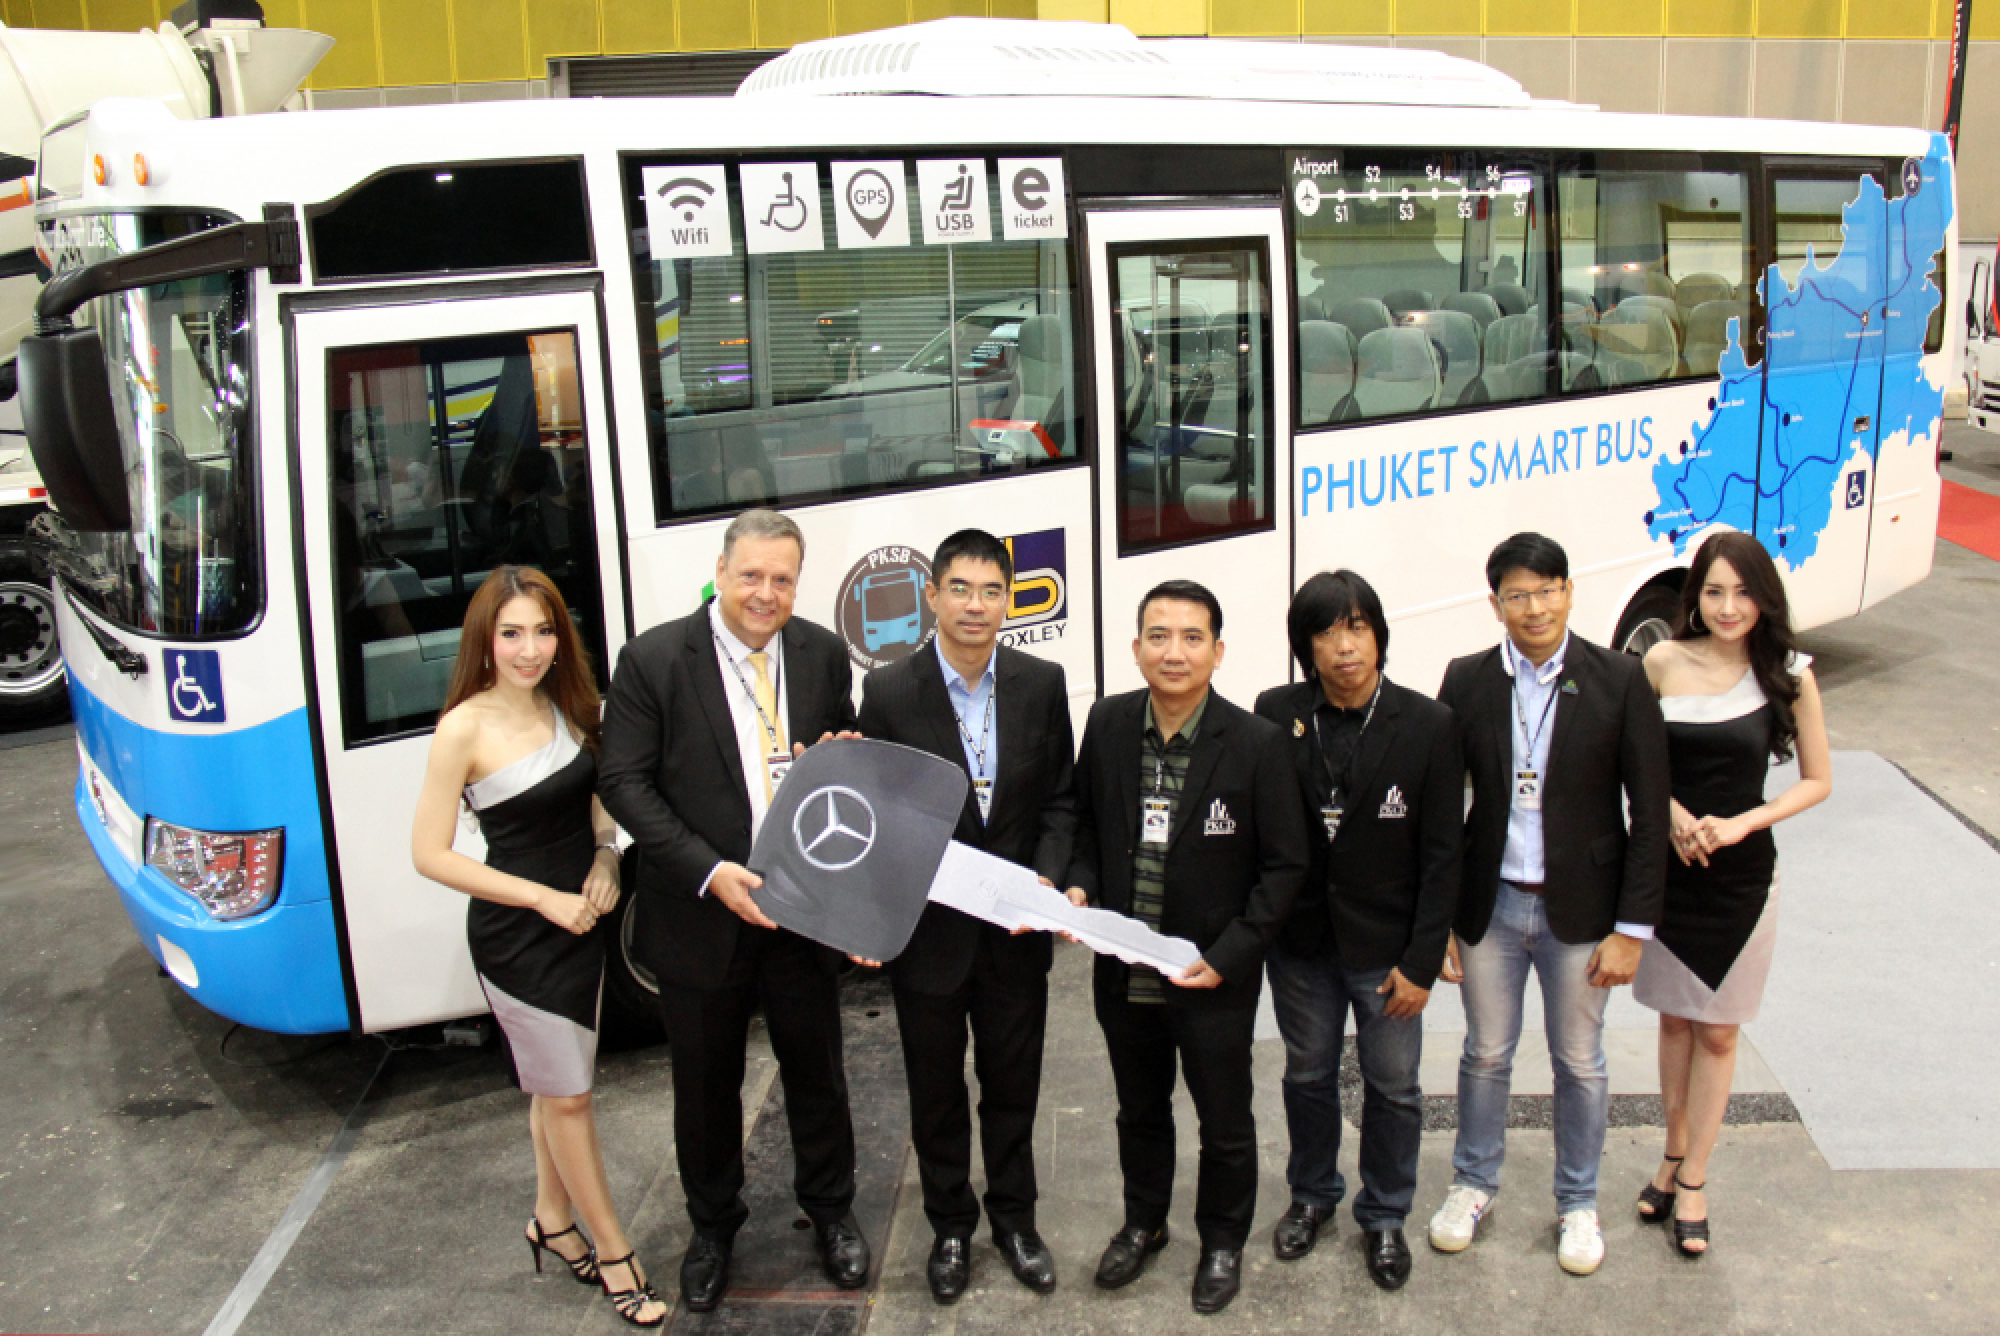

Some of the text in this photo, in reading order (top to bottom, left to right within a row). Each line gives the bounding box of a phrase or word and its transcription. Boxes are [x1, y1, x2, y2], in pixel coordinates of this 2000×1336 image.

[1293, 156, 1339, 179] Airport
[1365, 165, 1381, 183] S2
[1425, 164, 1442, 183] S4
[1485, 164, 1501, 182] S6
[853, 189, 888, 206] GPS
[1012, 167, 1051, 211] e
[1334, 204, 1349, 223] S1
[1399, 203, 1415, 221] S3
[1457, 201, 1473, 219] S5
[1513, 201, 1527, 217] S7
[935, 213, 975, 231] USB
[1013, 213, 1054, 229] ticket
[670, 228, 709, 246] Wifi
[1301, 415, 1653, 517] PHUKET SMART BUS
[867, 547, 911, 569] PKSB
[999, 622, 1067, 648] OXLEY
